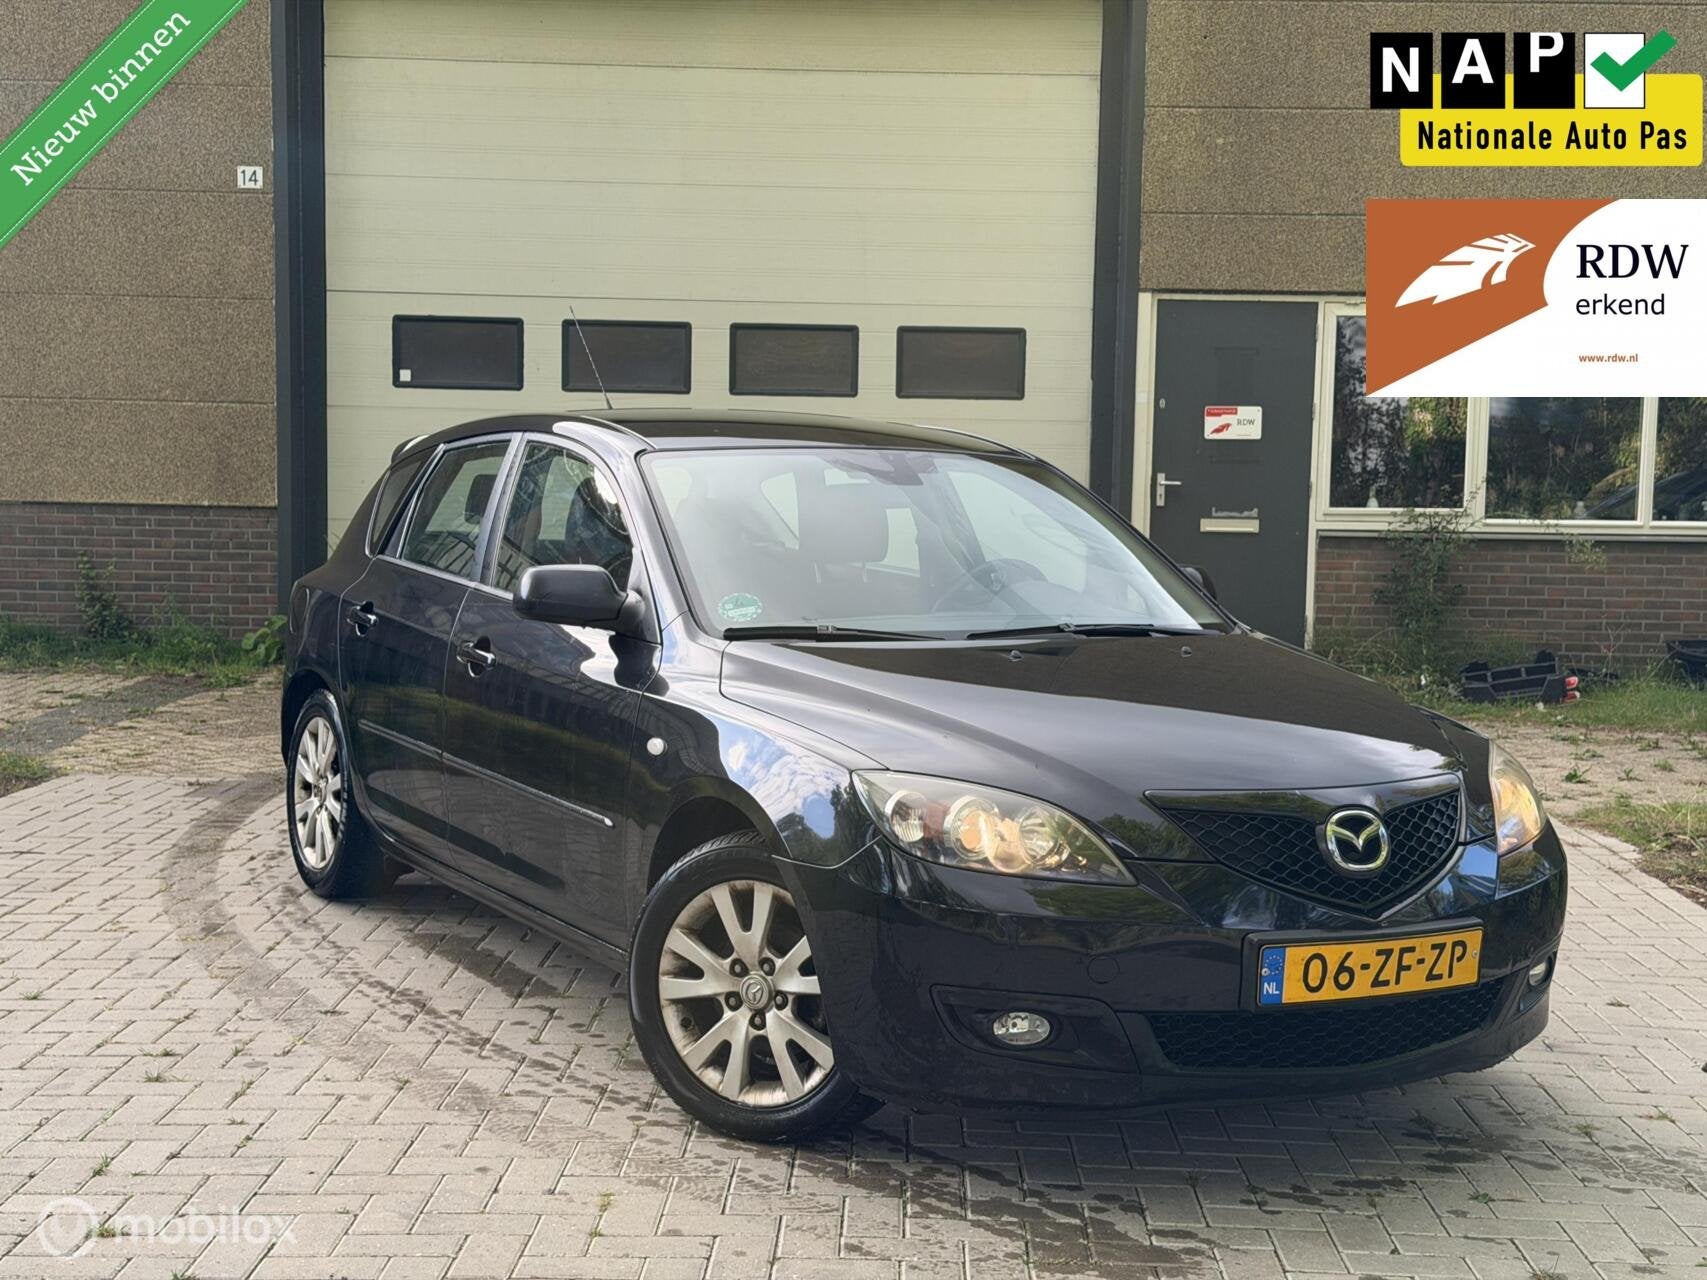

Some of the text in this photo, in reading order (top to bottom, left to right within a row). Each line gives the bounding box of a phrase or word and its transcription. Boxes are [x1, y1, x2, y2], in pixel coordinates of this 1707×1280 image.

[240, 169, 259, 185] 14
[1236, 418, 1256, 427] RDW
[1302, 939, 1468, 994] 06-ZF-ZP
[1263, 982, 1280, 995] NL
